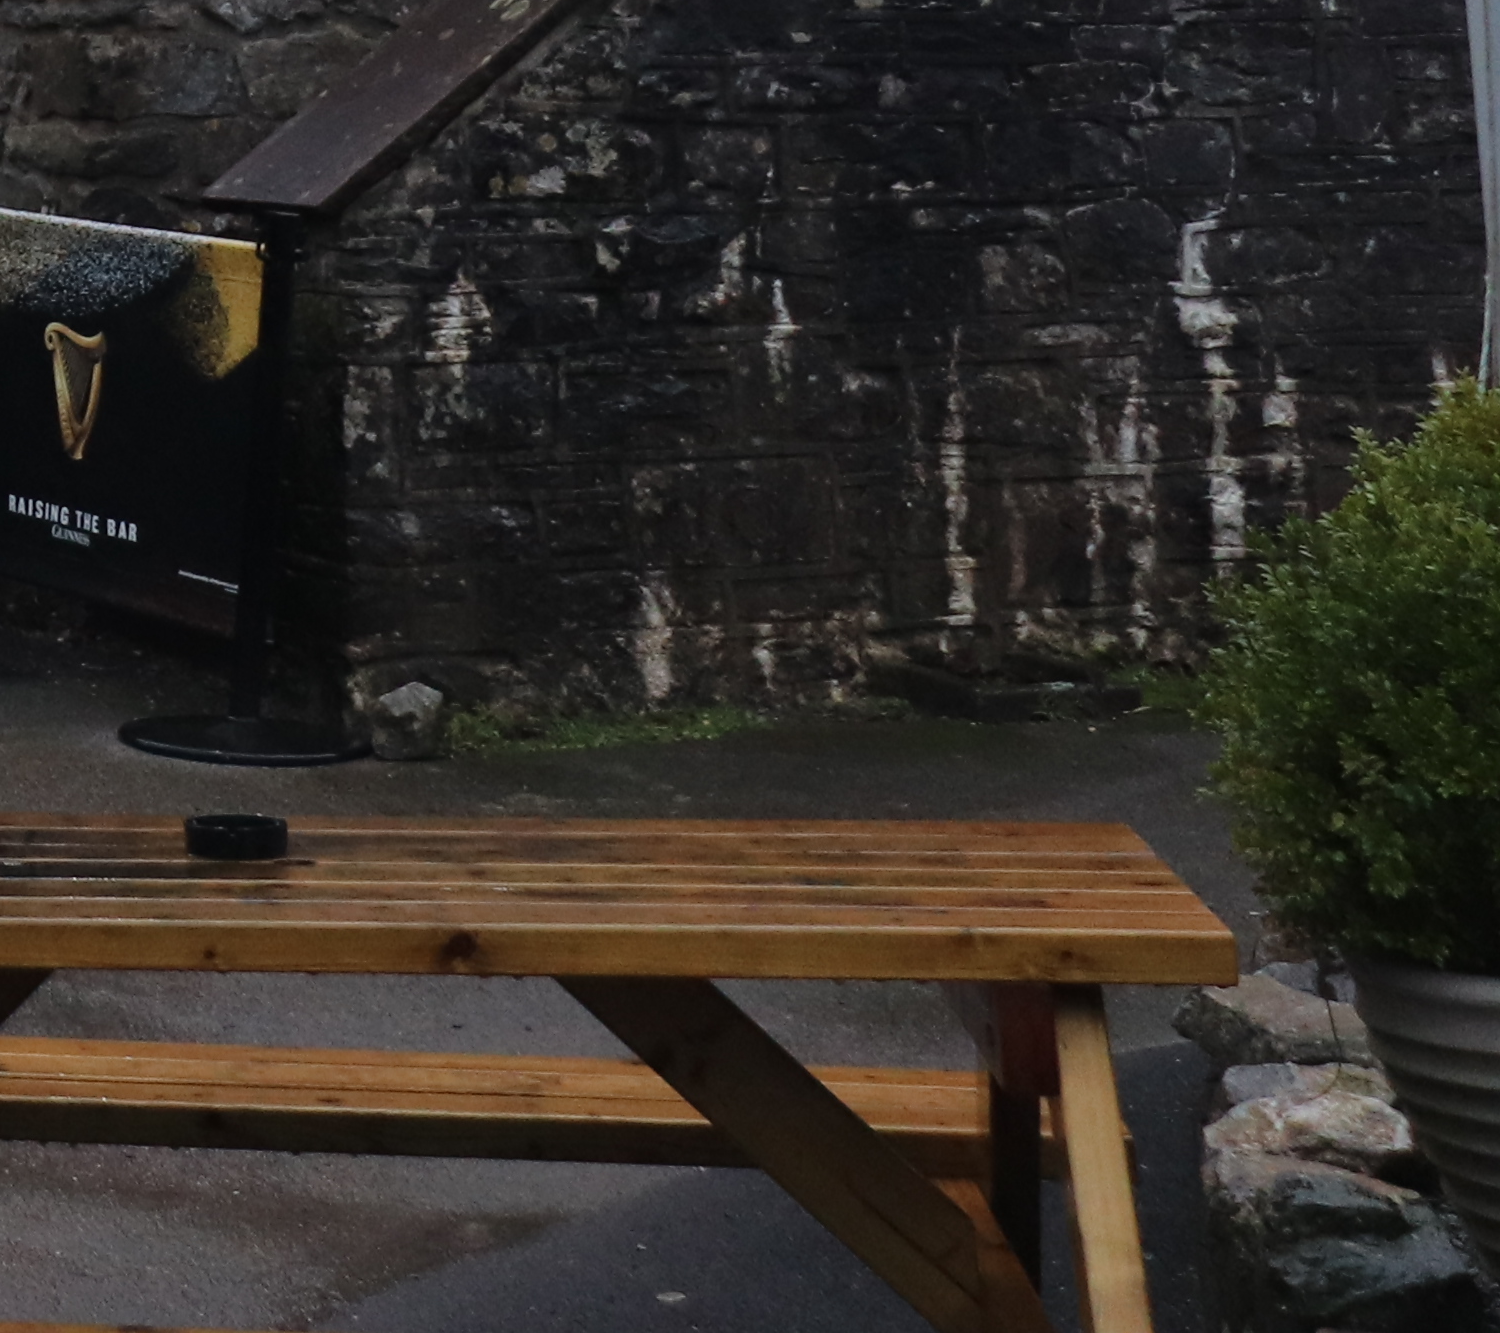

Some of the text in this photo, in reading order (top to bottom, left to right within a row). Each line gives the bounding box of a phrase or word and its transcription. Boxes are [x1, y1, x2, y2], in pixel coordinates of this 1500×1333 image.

[8, 494, 138, 543] RAISING THE BAR
